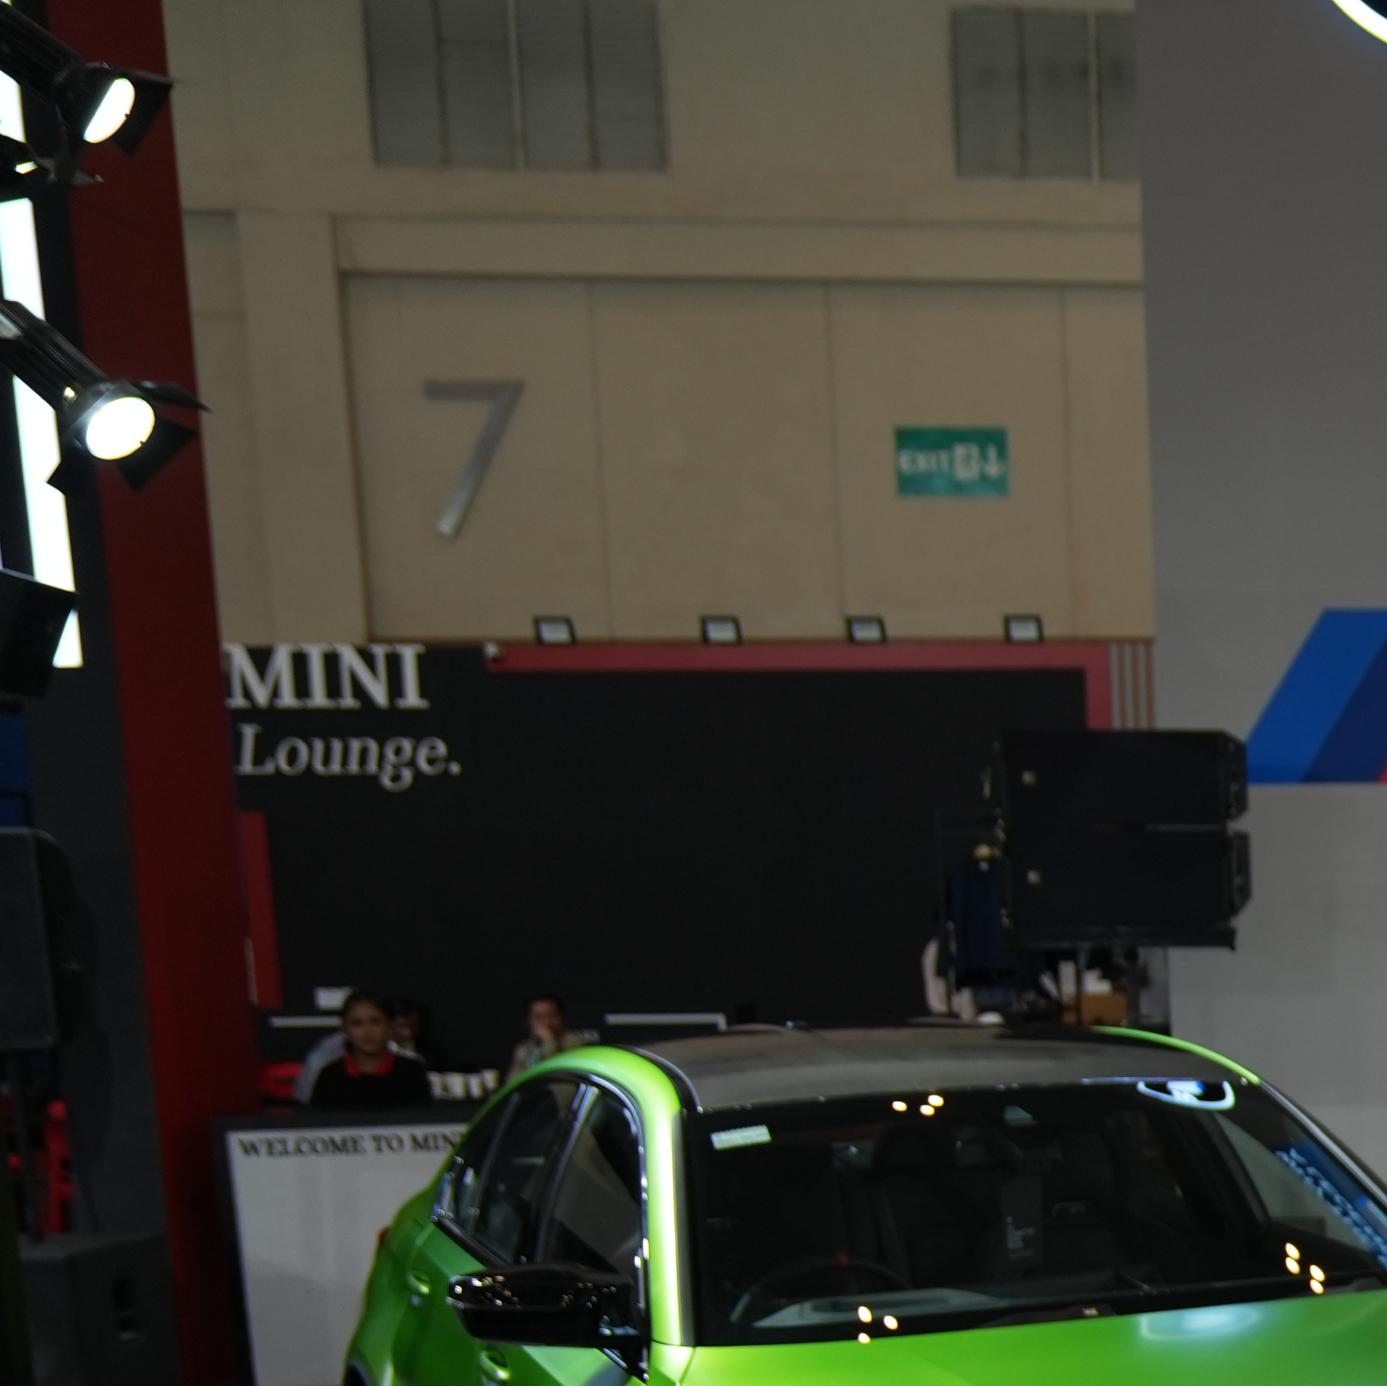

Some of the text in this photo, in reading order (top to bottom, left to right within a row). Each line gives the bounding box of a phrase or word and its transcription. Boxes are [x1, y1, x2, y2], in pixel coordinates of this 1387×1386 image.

[424, 379, 525, 538] 7
[224, 642, 430, 710] MINI
[235, 722, 463, 793] Lounge.
[238, 1134, 365, 1157] WELCOME
[370, 1133, 403, 1153] TO
